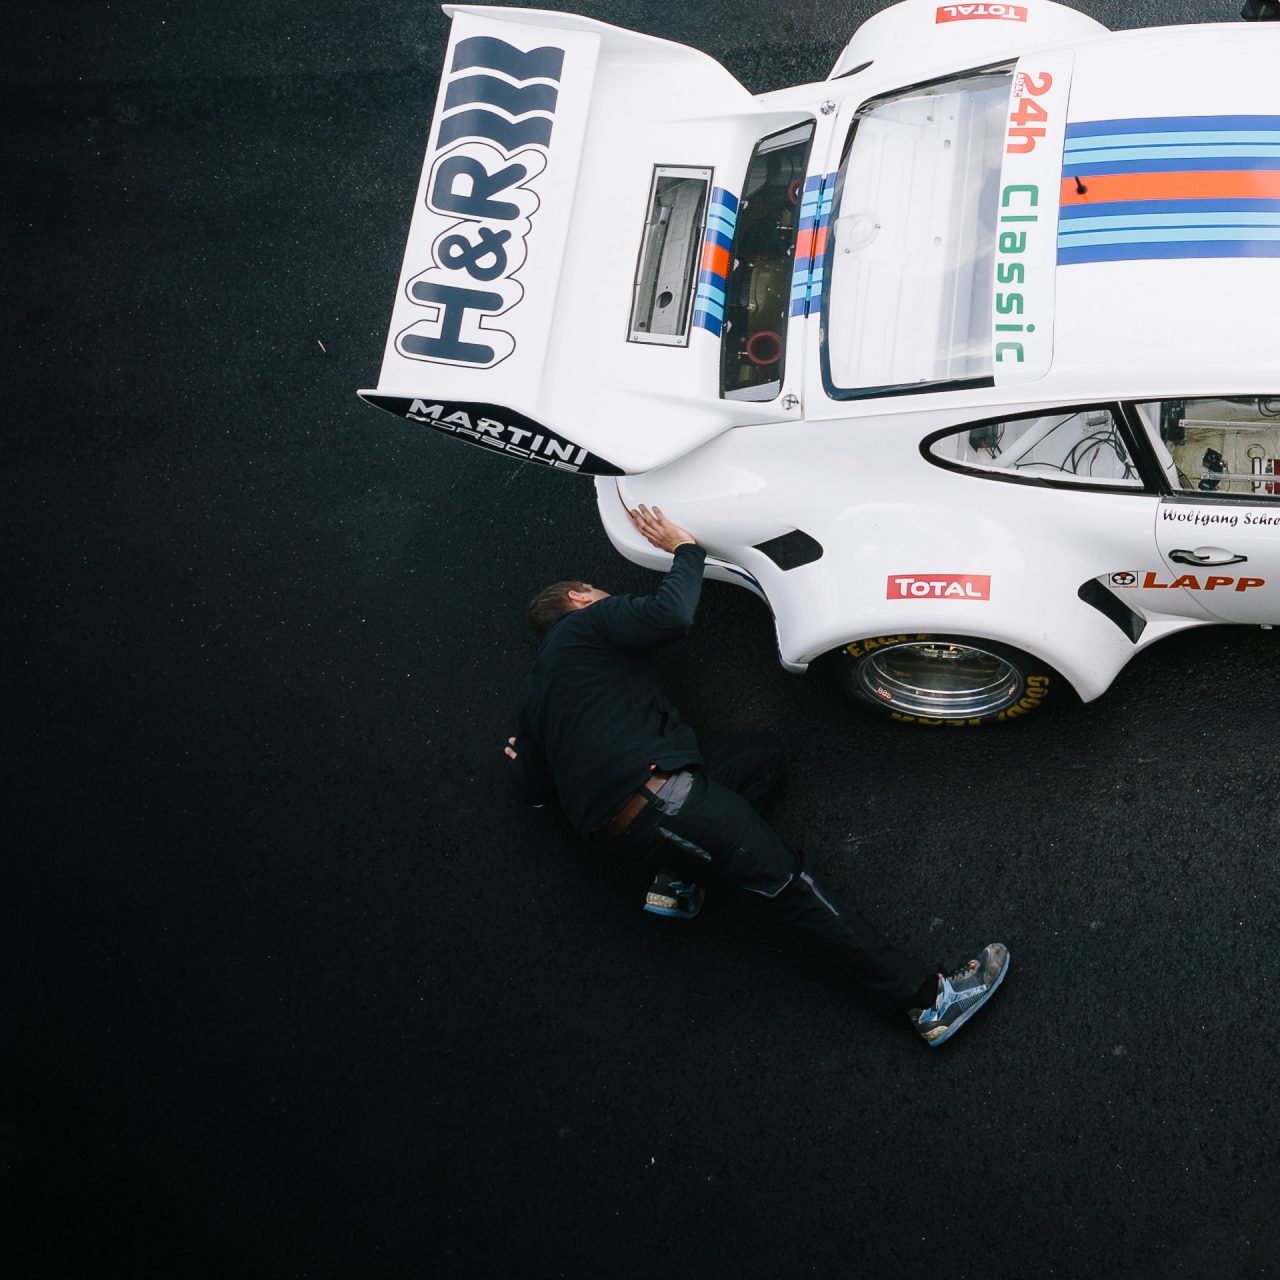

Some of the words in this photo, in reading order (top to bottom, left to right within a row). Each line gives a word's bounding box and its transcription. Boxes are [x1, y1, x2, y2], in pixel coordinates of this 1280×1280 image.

[943, 4, 1021, 20] TOTAL
[1006, 71, 1053, 154] 24h
[398, 144, 545, 368] H&R
[995, 184, 1039, 363] Classic
[405, 412, 580, 473] PORSCHE
[408, 398, 589, 466] MARTINI
[1162, 509, 1239, 528] Wolfgang
[894, 577, 982, 598] TOTAL
[1142, 571, 1266, 593] LAPP
